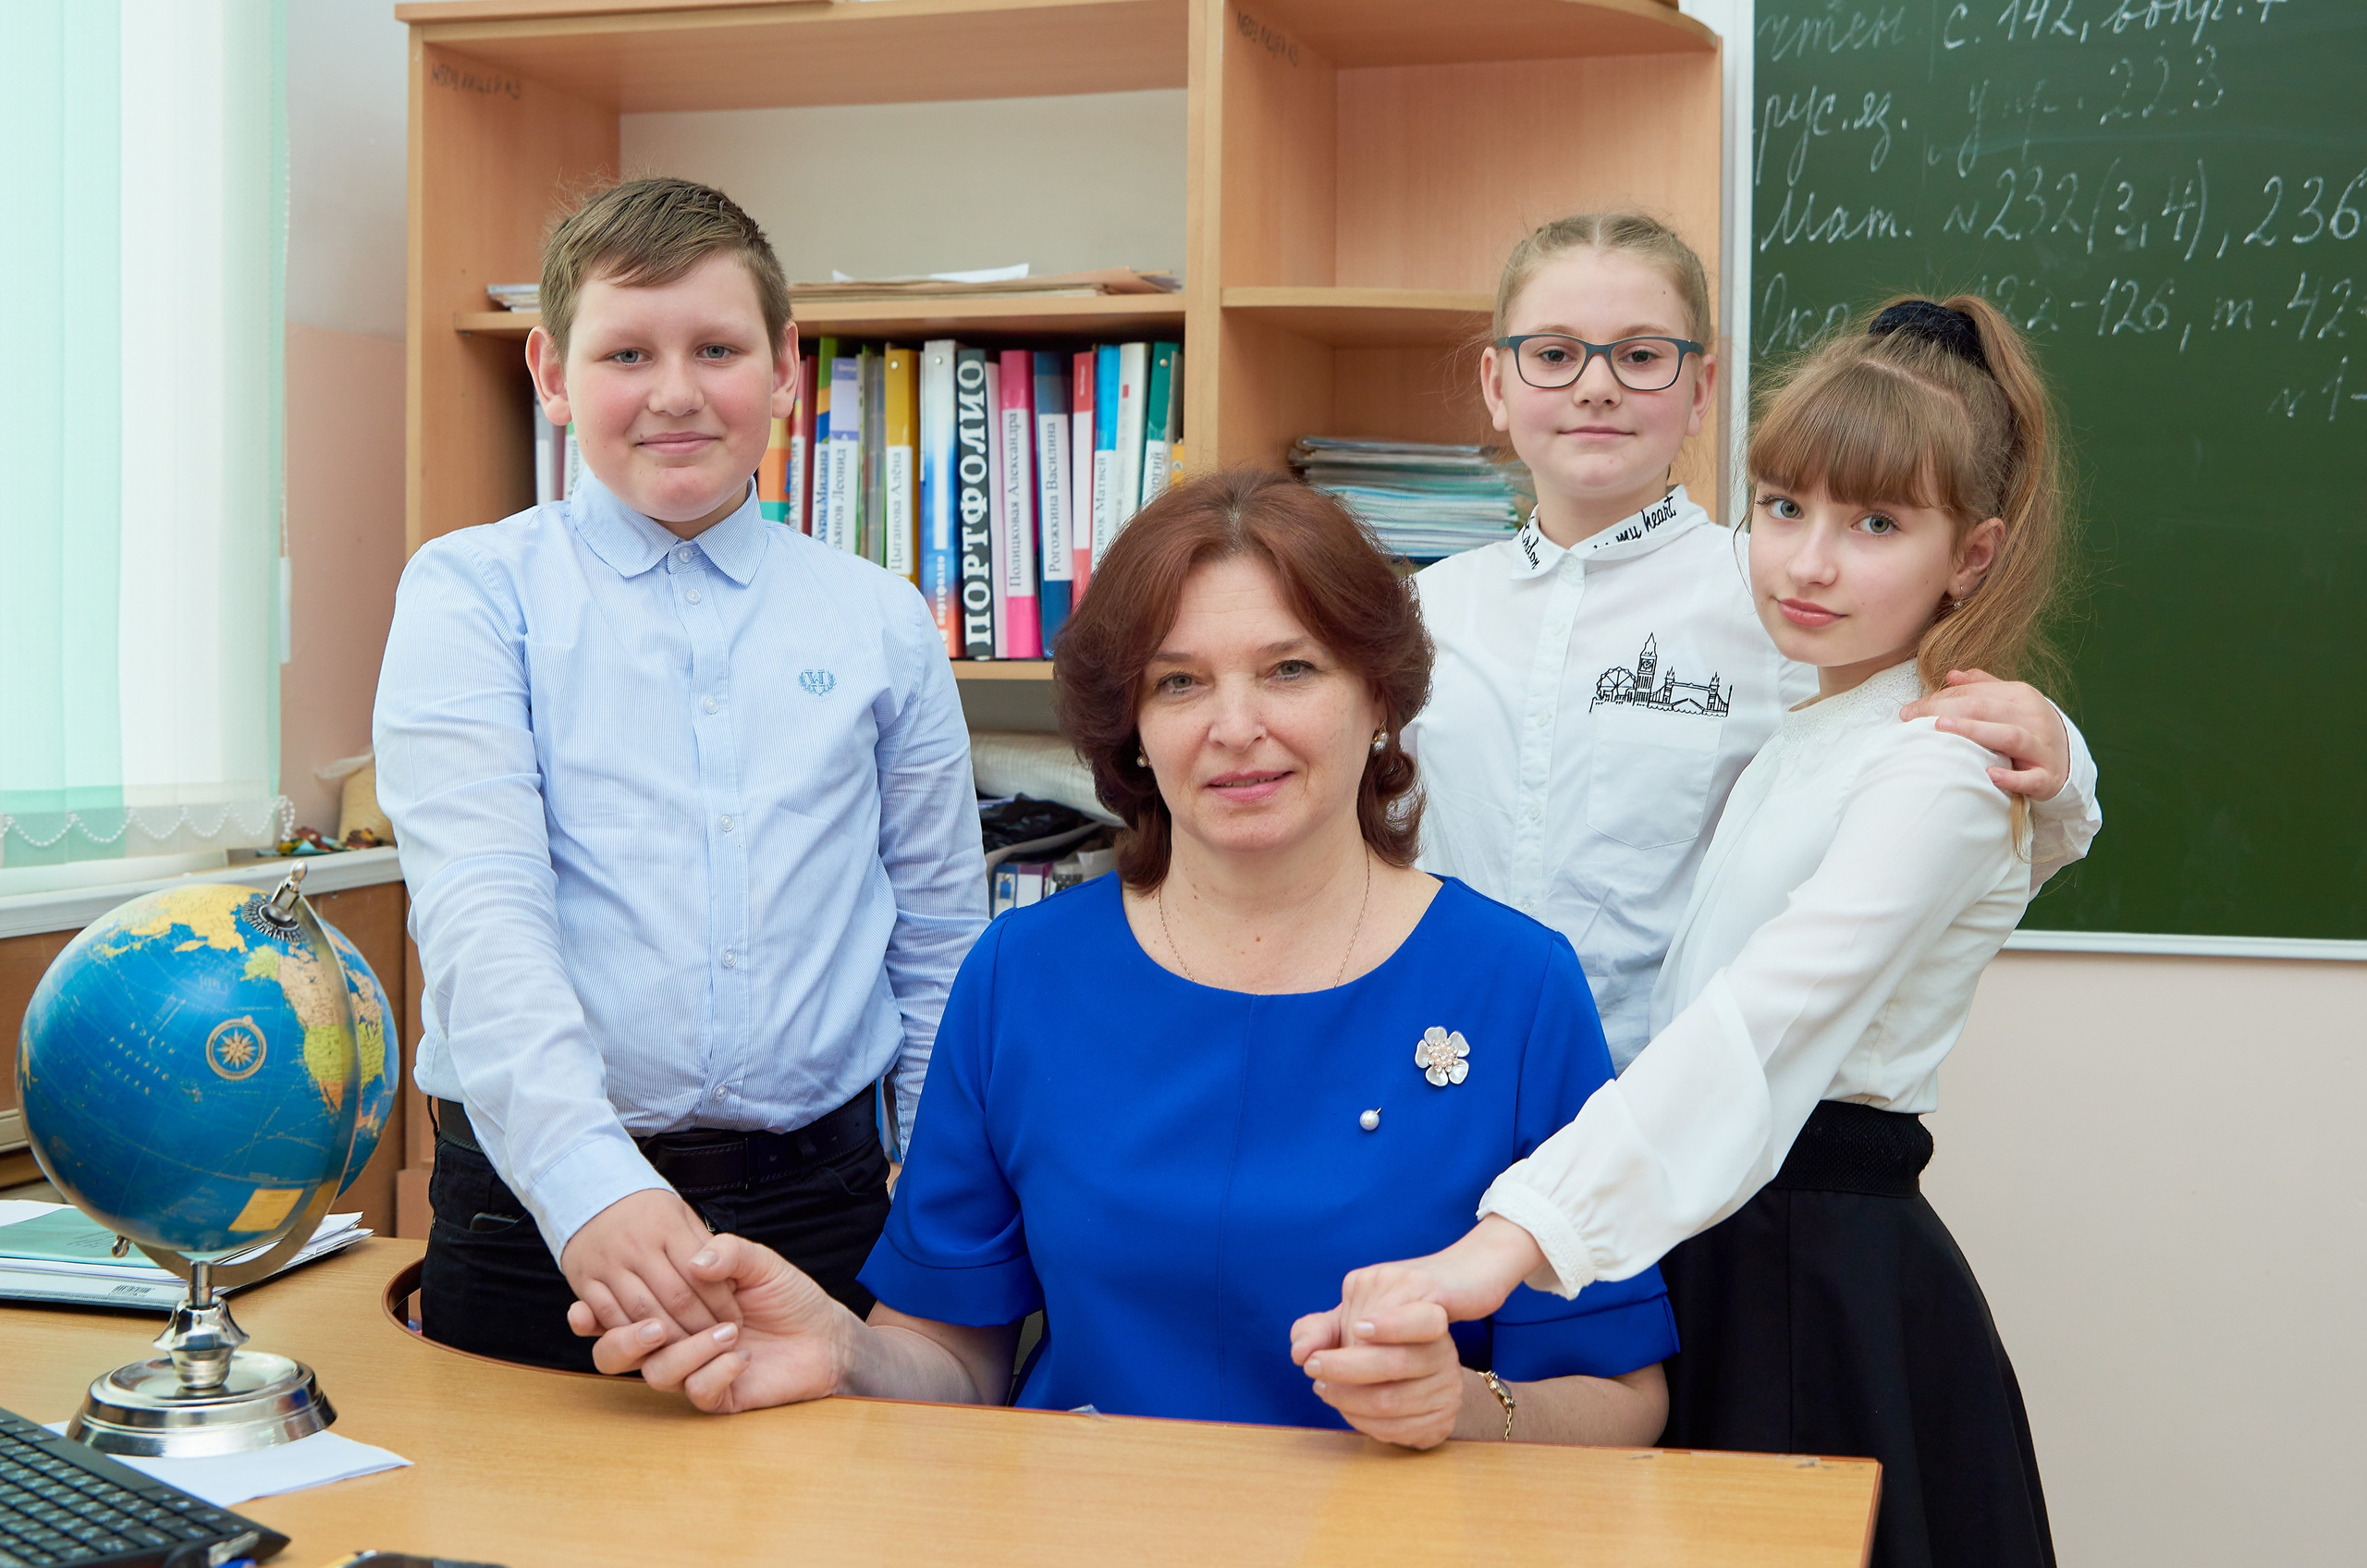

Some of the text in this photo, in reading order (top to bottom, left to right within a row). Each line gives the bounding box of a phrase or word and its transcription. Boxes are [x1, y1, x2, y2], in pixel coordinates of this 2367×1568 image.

[816, 450, 828, 504] Милана
[832, 448, 847, 550] сьянов Леонид
[890, 451, 903, 570] Цыганова Алёна
[957, 360, 991, 646] ПОРТФОЛИО
[1008, 412, 1022, 587] Полицковая Александра
[1046, 423, 1061, 572] Рогожкина Василина
[1095, 457, 1106, 511] Матвей
[1640, 496, 1677, 533] heart
